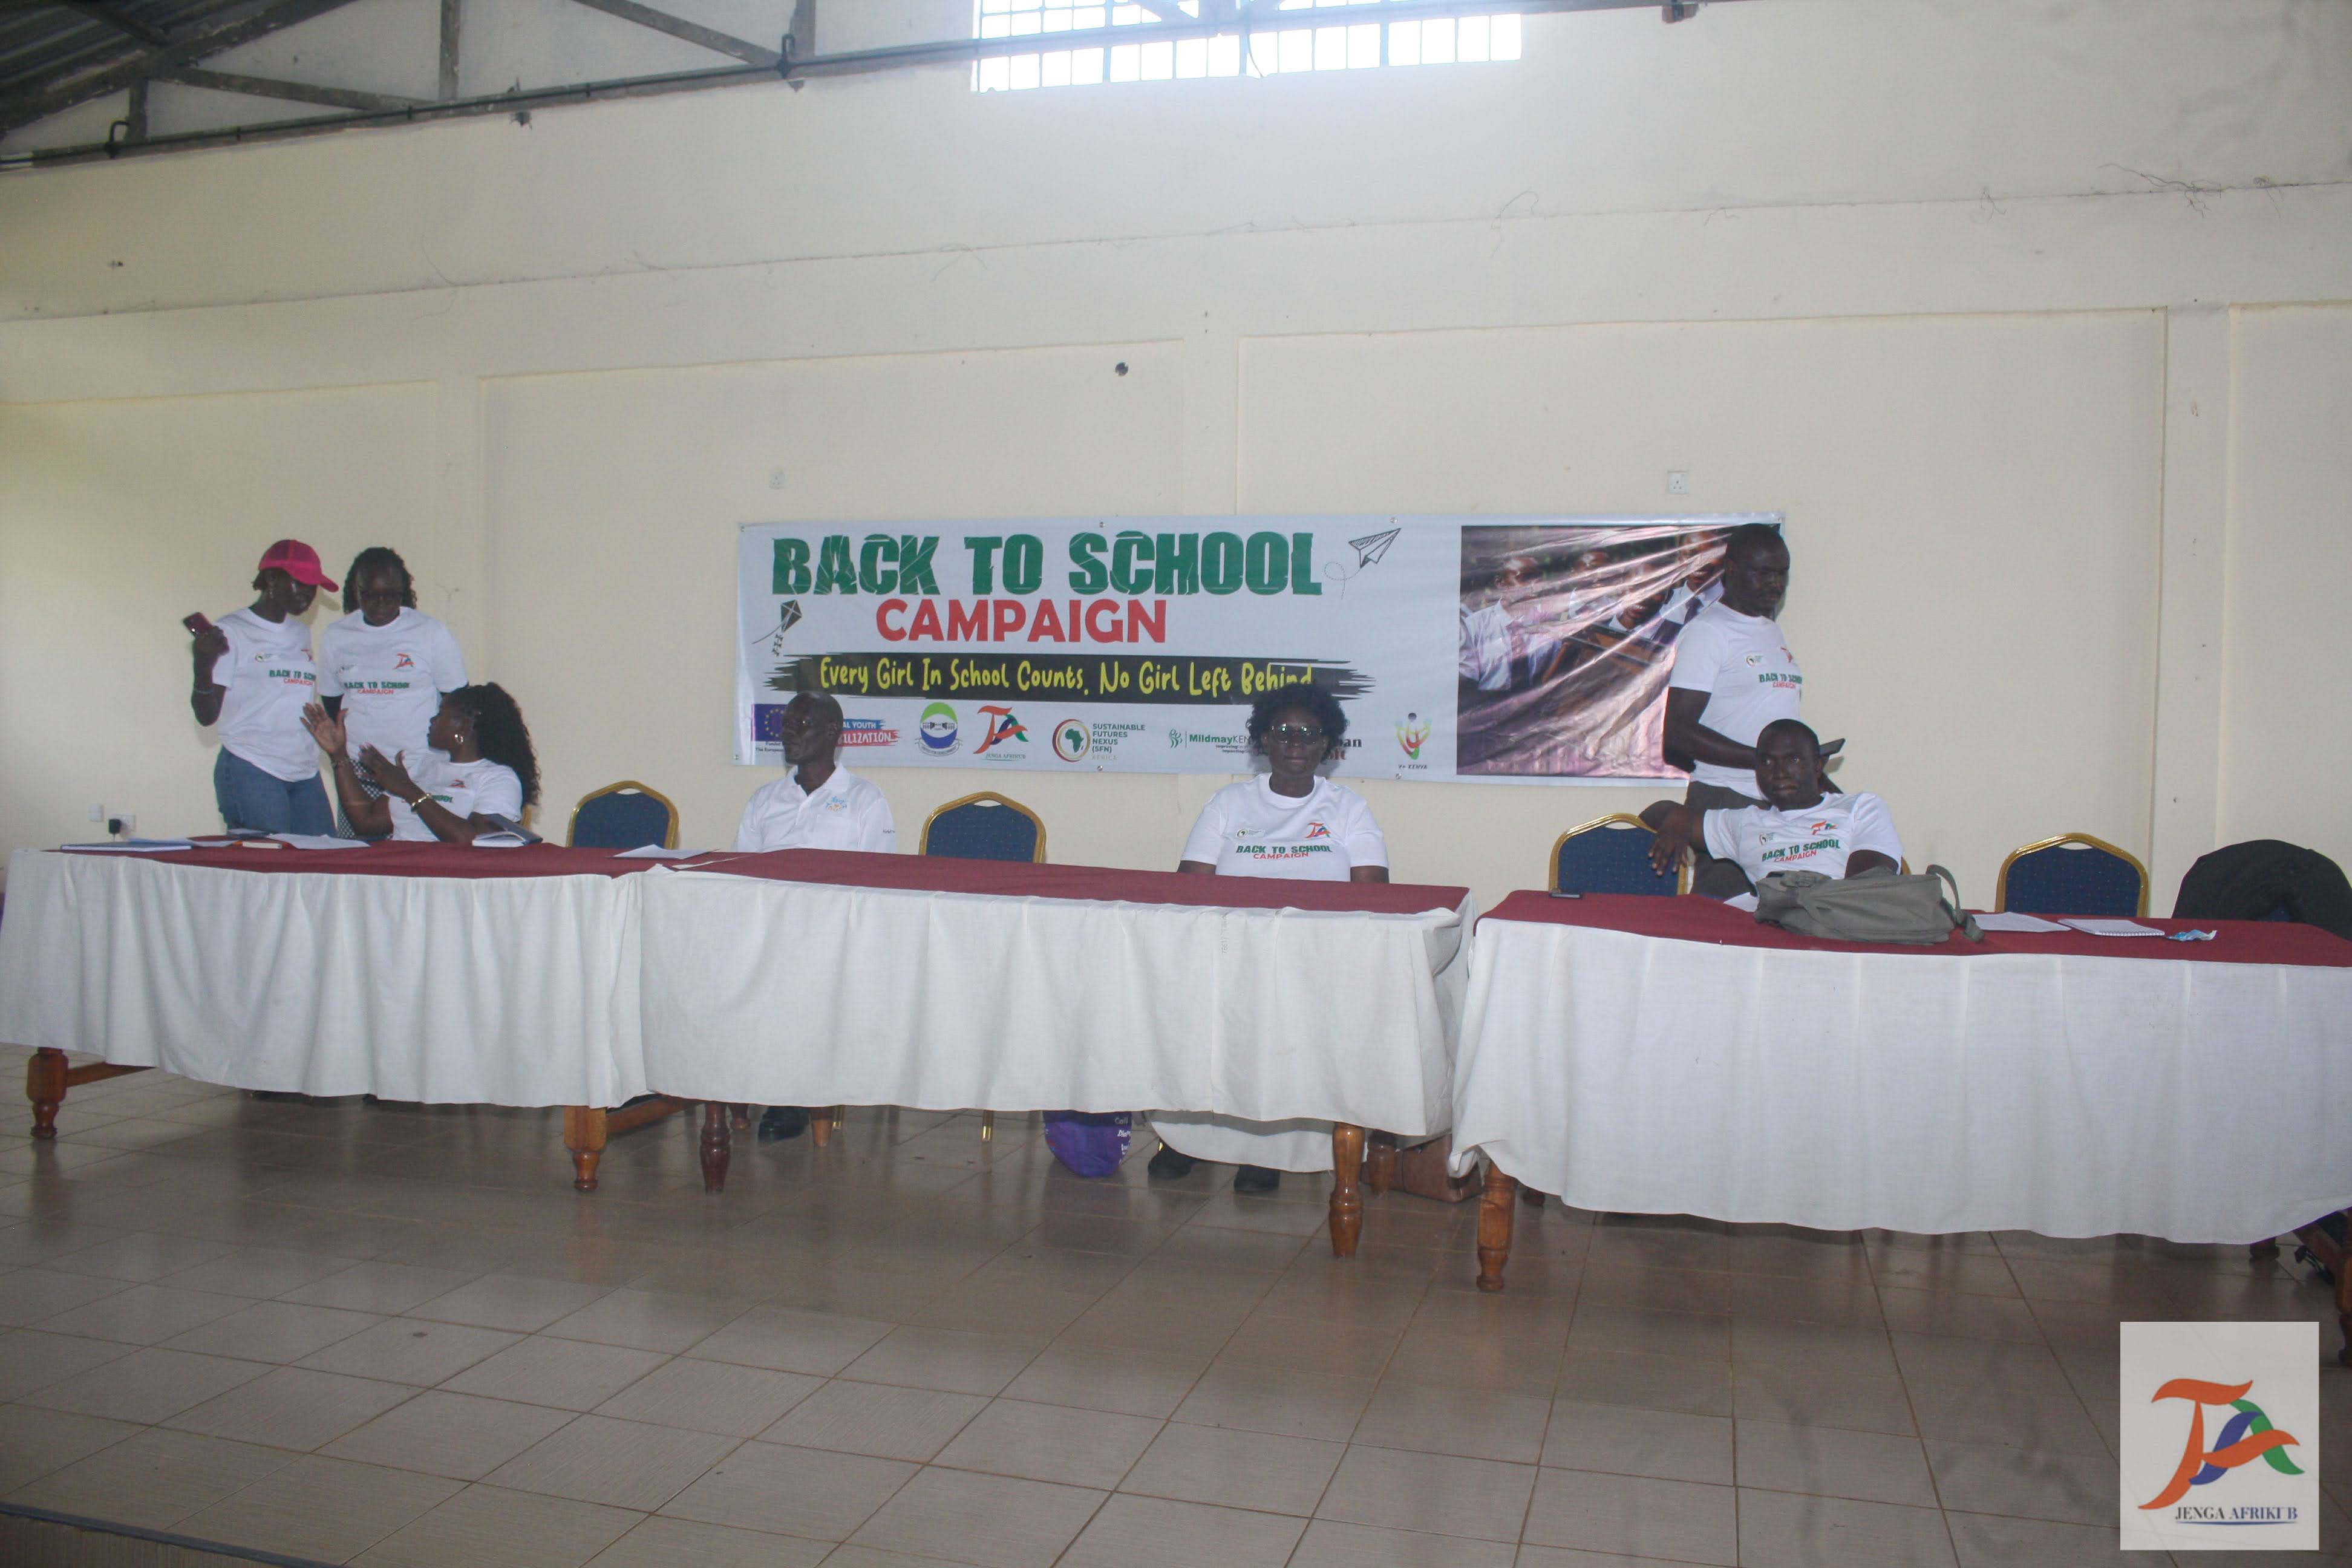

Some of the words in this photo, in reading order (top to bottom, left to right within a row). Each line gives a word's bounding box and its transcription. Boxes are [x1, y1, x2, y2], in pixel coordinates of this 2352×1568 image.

[772, 534, 941, 595] BACK
[964, 534, 1044, 595] TO
[1069, 530, 1322, 596] SCHOOL
[876, 598, 1166, 642] CAMPAIGN
[820, 656, 868, 694] Every
[877, 657, 914, 689] Girl
[921, 657, 942, 691] In
[950, 658, 1010, 691] School
[1099, 661, 1130, 694] No
[1138, 661, 1180, 695] Girl
[1189, 661, 1232, 698] Left
[1236, 845, 1266, 854] BACK
[1253, 851, 1309, 860] CAMPAIGN
[1762, 848, 1785, 862] BACK
[1789, 844, 1800, 855] TO
[1803, 838, 1841, 852] SCHOOL
[1774, 849, 1817, 863] CAMPAIGN
